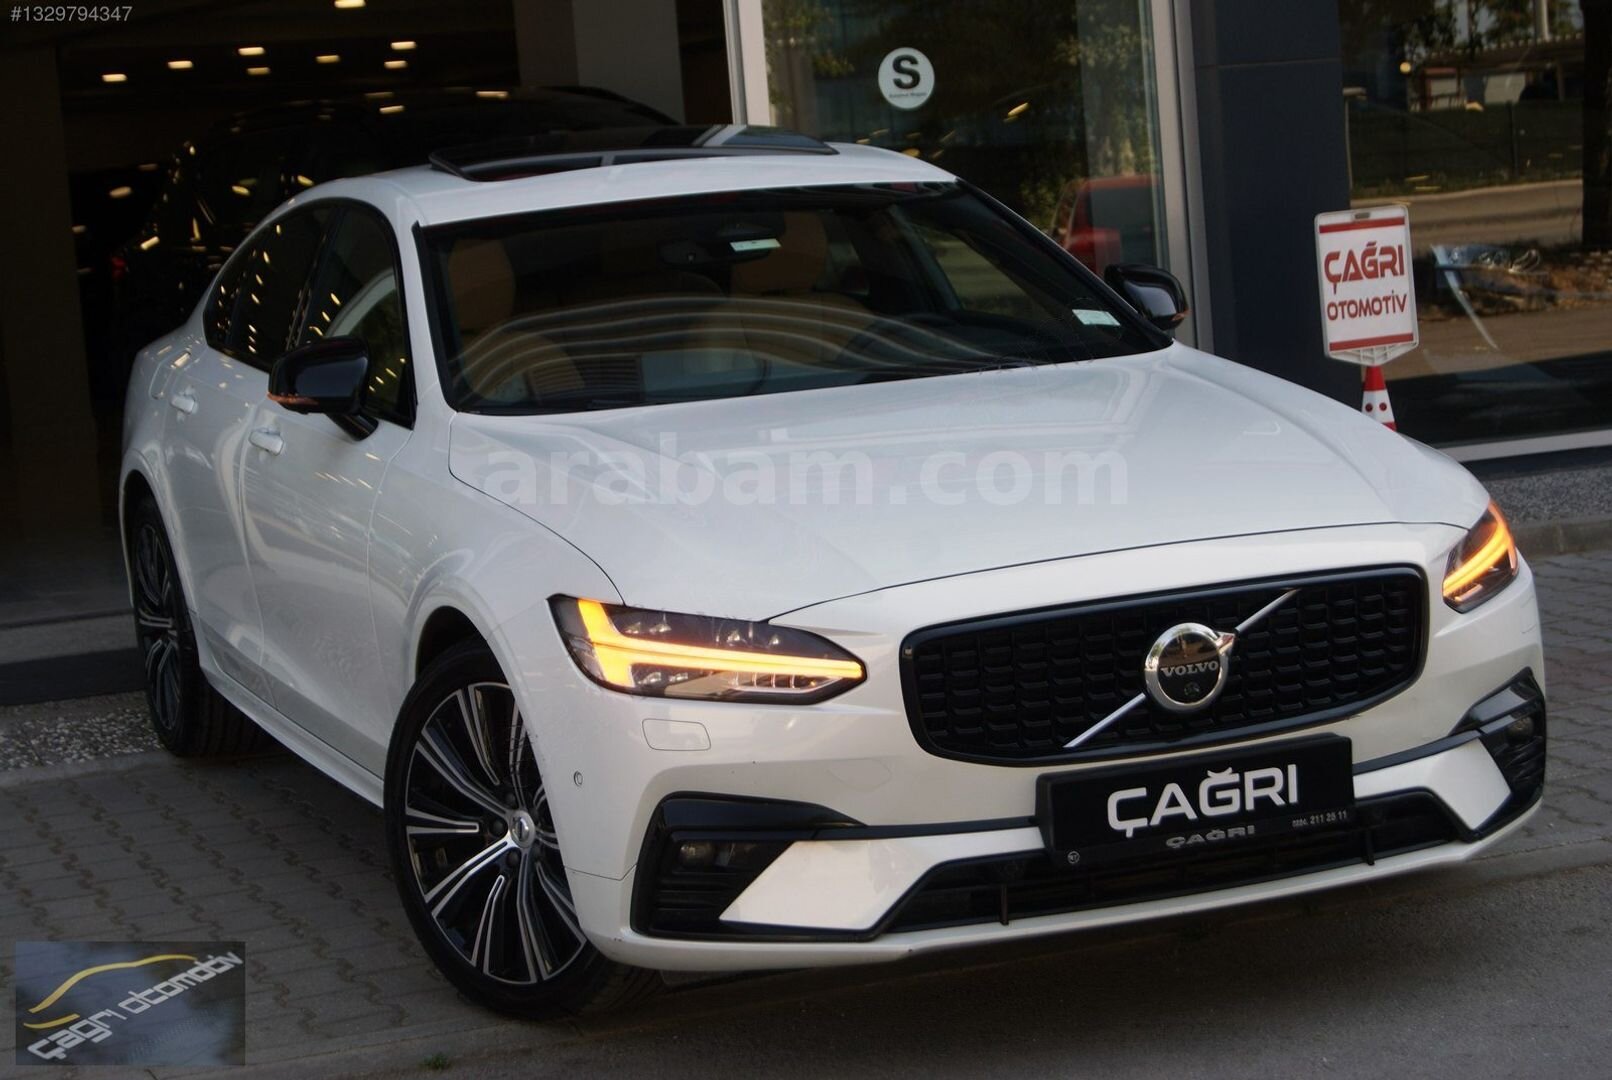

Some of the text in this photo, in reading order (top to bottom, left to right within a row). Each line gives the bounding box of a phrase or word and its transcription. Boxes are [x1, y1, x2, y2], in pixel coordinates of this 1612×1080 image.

[892, 54, 921, 89] S
[1324, 242, 1405, 295] ÇAĞRI
[1326, 290, 1407, 321] OTOMOTİV
[1160, 660, 1219, 677] VOLVO
[1107, 764, 1299, 838] ÇAĞRI
